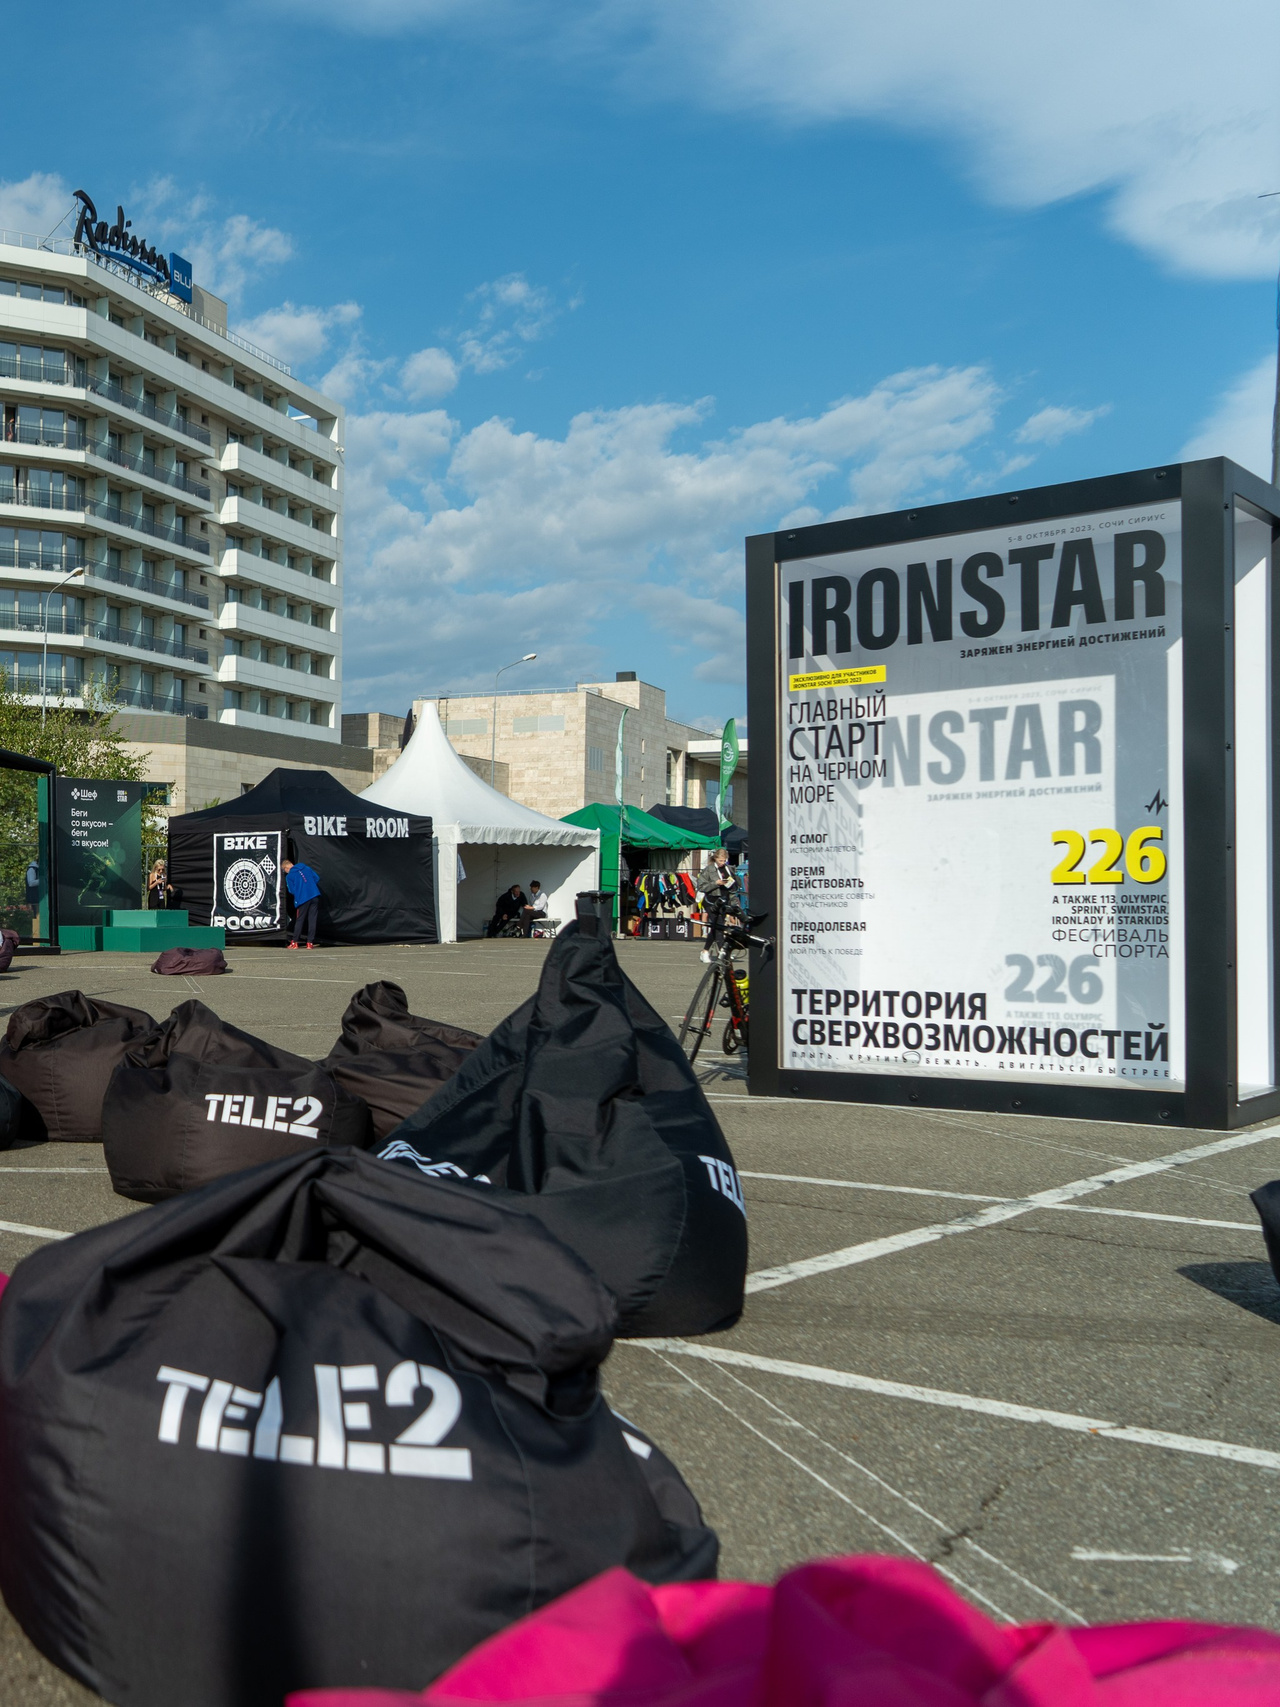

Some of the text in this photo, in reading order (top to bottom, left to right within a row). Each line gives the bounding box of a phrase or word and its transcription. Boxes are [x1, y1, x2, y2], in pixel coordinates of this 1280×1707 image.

[73, 190, 172, 281] Radisson
[173, 270, 192, 289] BLU
[1026, 529, 1067, 540] ОКТЯБРЯ
[1070, 525, 1095, 534] 2023,
[1099, 520, 1124, 529] СОЧИ
[1128, 513, 1166, 525] СИРИУС
[788, 530, 1166, 659] IRONSTAR
[960, 625, 1166, 659] ЗАРЯЖЕН ЭНЕРГИЕЙ ДОСТИЖЕНИЙ
[793, 674, 830, 683] ЭКСКЛЮЗИВНО
[843, 669, 877, 677] УЧАСТНИКОВ
[793, 681, 817, 689] IRONSTAR
[789, 689, 886, 724] ГЛАВНЫЙ
[789, 720, 886, 761] СТАРТ
[790, 759, 887, 783] НА ЧЕРНОМ
[81, 789, 98, 800] Шеф
[790, 784, 835, 804] МОРЕ
[71, 808, 88, 817] Беги
[81, 820, 107, 829] вкусом
[304, 815, 410, 839] BIKE ROOM
[71, 828, 88, 837] беги
[790, 833, 828, 844] Я СМОГ
[81, 839, 109, 849] вкусом!
[223, 836, 268, 850] BIKE
[789, 845, 857, 854] ИСТОРИИ АТЛЕТОВ
[1051, 826, 1167, 885] 226
[790, 866, 825, 876] ВРЕМЯ
[790, 876, 864, 891] ДЕЙСТВОВАТЬ
[846, 892, 875, 900] СОВЕТЫ
[1062, 895, 1097, 904] ТАКЖЕ
[1100, 895, 1118, 905] 113,
[1120, 894, 1169, 905] OLYMPIC,
[1071, 905, 1169, 915] SPRINT, SWIMSTAR,
[213, 915, 272, 931] ROOM
[790, 921, 866, 933] ПРЕОДОЛЕВАЯ
[1052, 916, 1169, 925] IRONLADY И STARKIDS
[790, 934, 815, 944] СЕБЯ
[1052, 928, 1169, 942] ФЕСТИВАЛЬ
[789, 947, 807, 955] МОЙ
[835, 948, 863, 956] ПОБЕДЕ
[1092, 944, 1169, 958] СПОРТА
[791, 988, 987, 1020] ТЕРРИТОРИЯ
[792, 1018, 1168, 1062] СВЕРХВОЗМОЖНОСТЕЙ
[791, 1051, 839, 1060] ПЛЫТЬ.
[926, 1057, 987, 1067] БЕЖАТЬ.
[998, 1062, 1085, 1073] ДВИГАТЬСЯ
[1098, 1067, 1169, 1078] БЫСТРЕЕ
[205, 1094, 323, 1139] TELE2
[156, 1360, 472, 1481] TELE2
